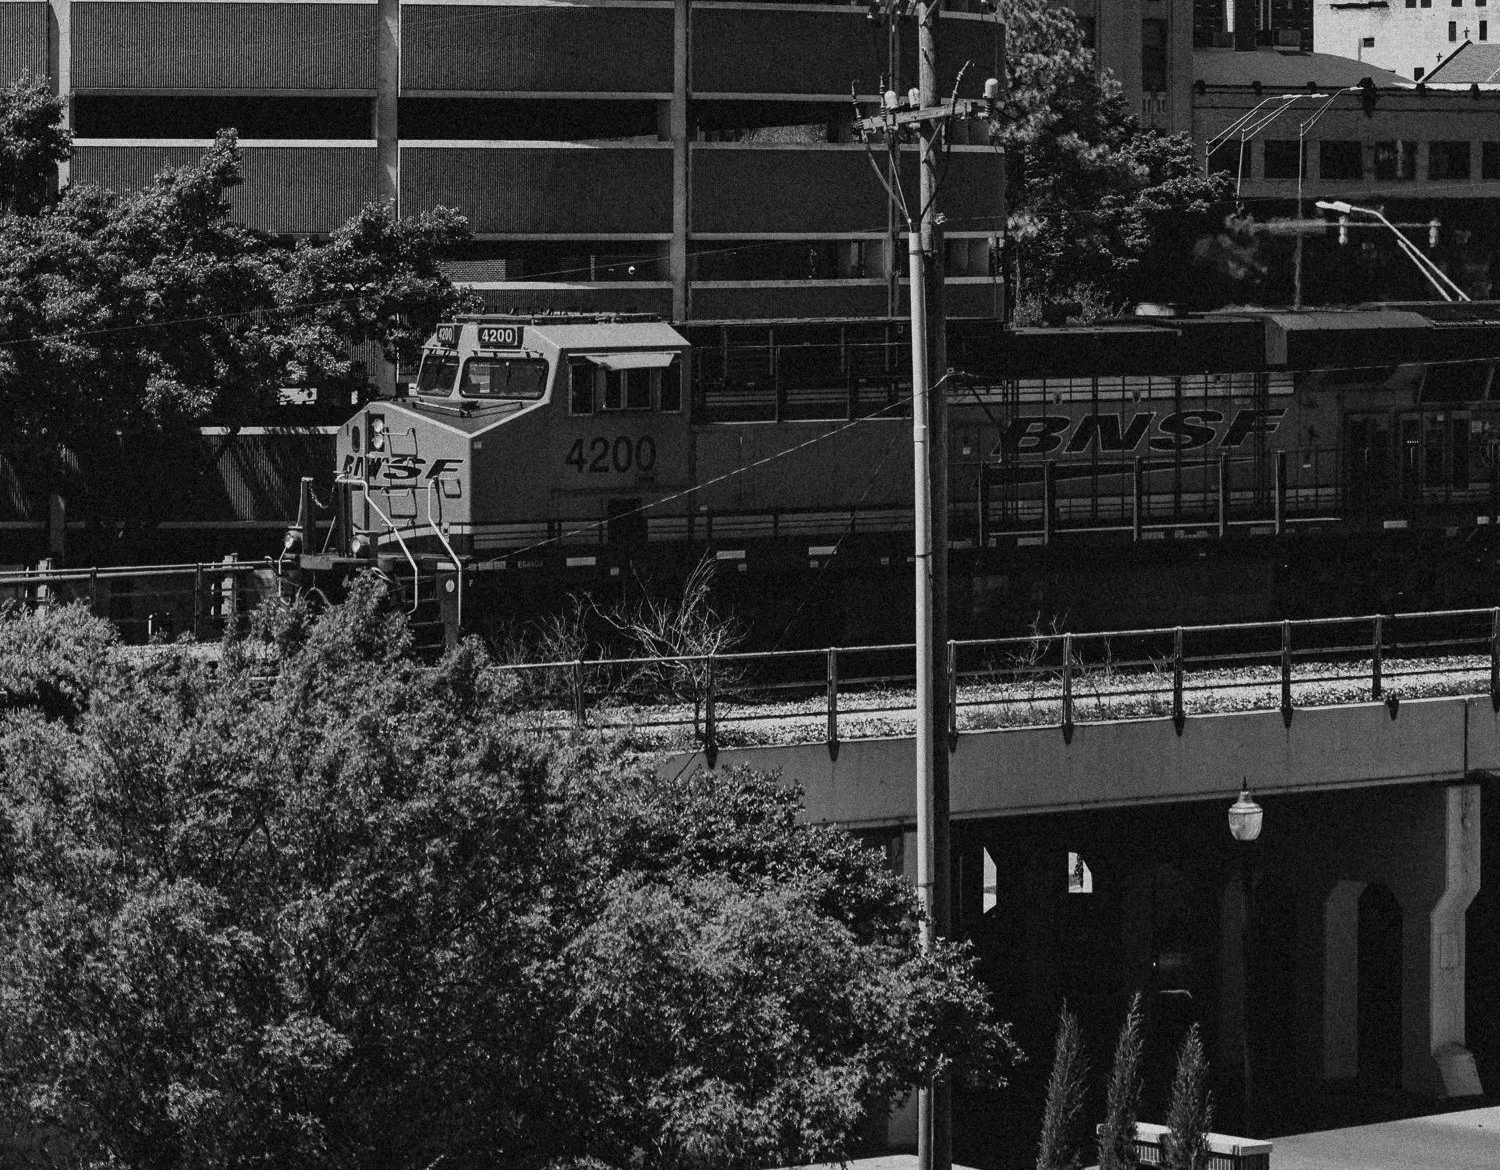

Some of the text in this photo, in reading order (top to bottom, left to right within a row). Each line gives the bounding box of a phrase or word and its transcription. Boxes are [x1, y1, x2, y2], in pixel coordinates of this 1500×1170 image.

[437, 325, 453, 342] 4200
[481, 327, 513, 343] 4200
[990, 407, 1288, 456] BNSF
[343, 454, 465, 480] BNSF
[565, 435, 657, 474] 4200
